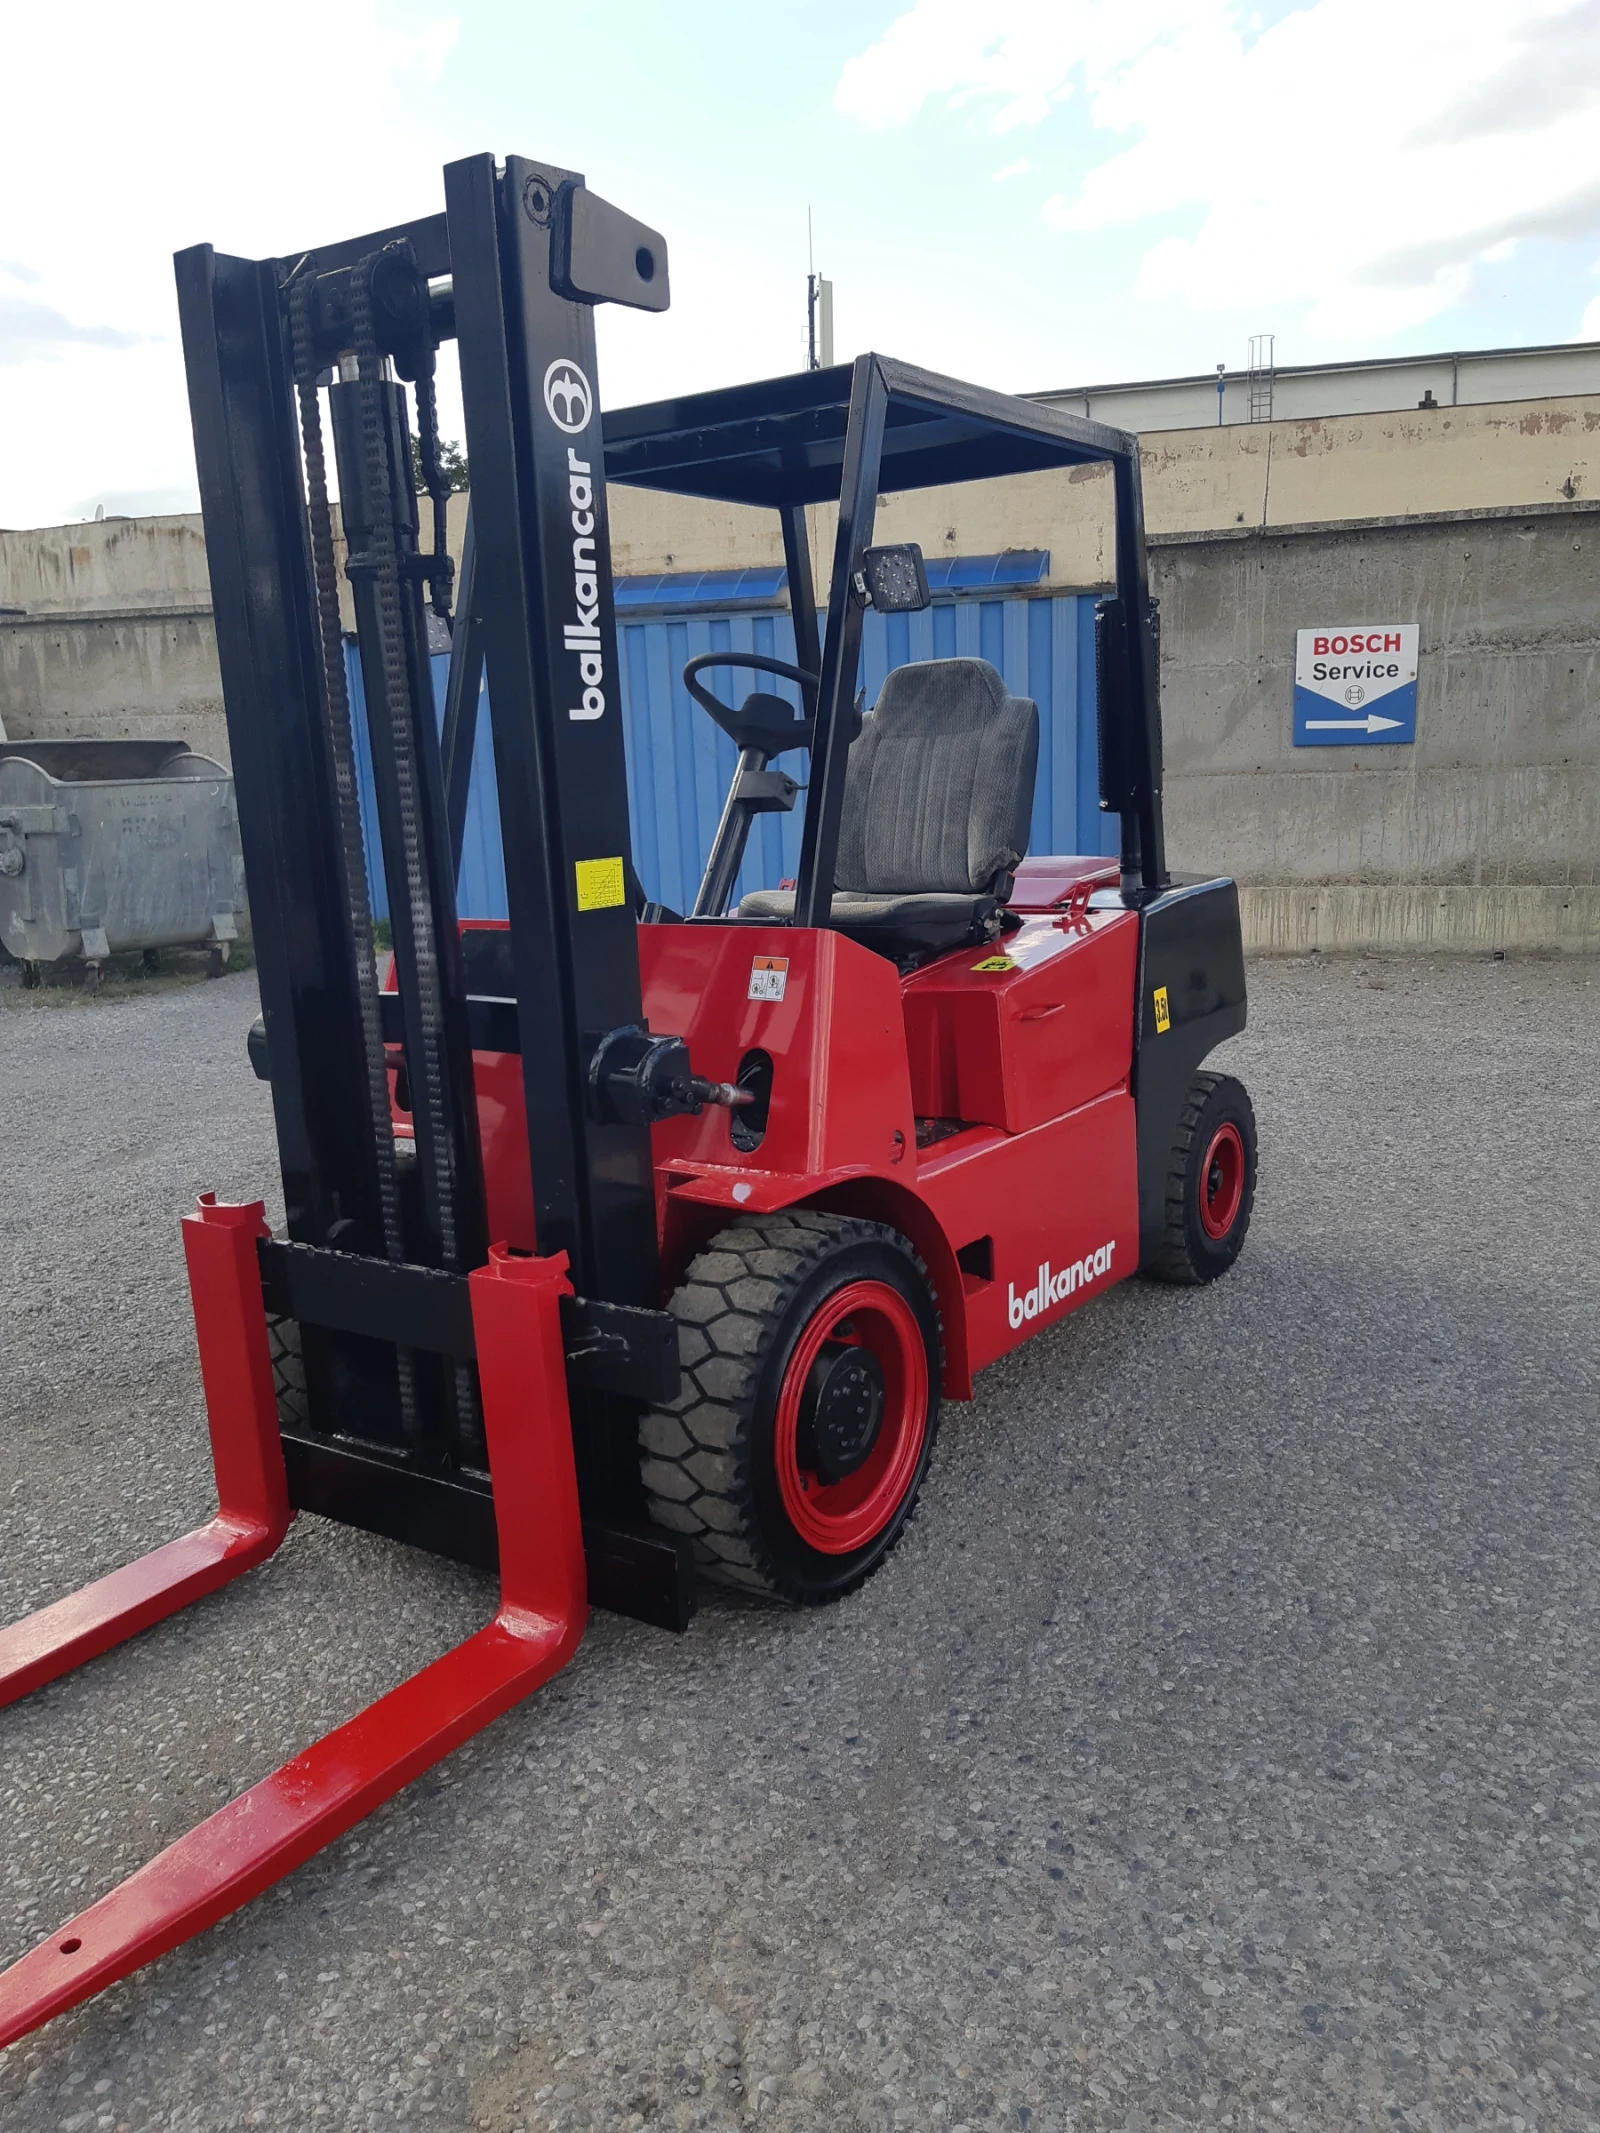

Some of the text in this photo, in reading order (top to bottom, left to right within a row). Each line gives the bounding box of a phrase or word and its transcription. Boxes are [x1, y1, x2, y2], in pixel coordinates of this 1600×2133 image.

[563, 448, 605, 721] balkancar
[1313, 633, 1401, 655] BOSCH
[1313, 661, 1399, 681] Service
[1008, 1240, 1115, 1329] balkancar
